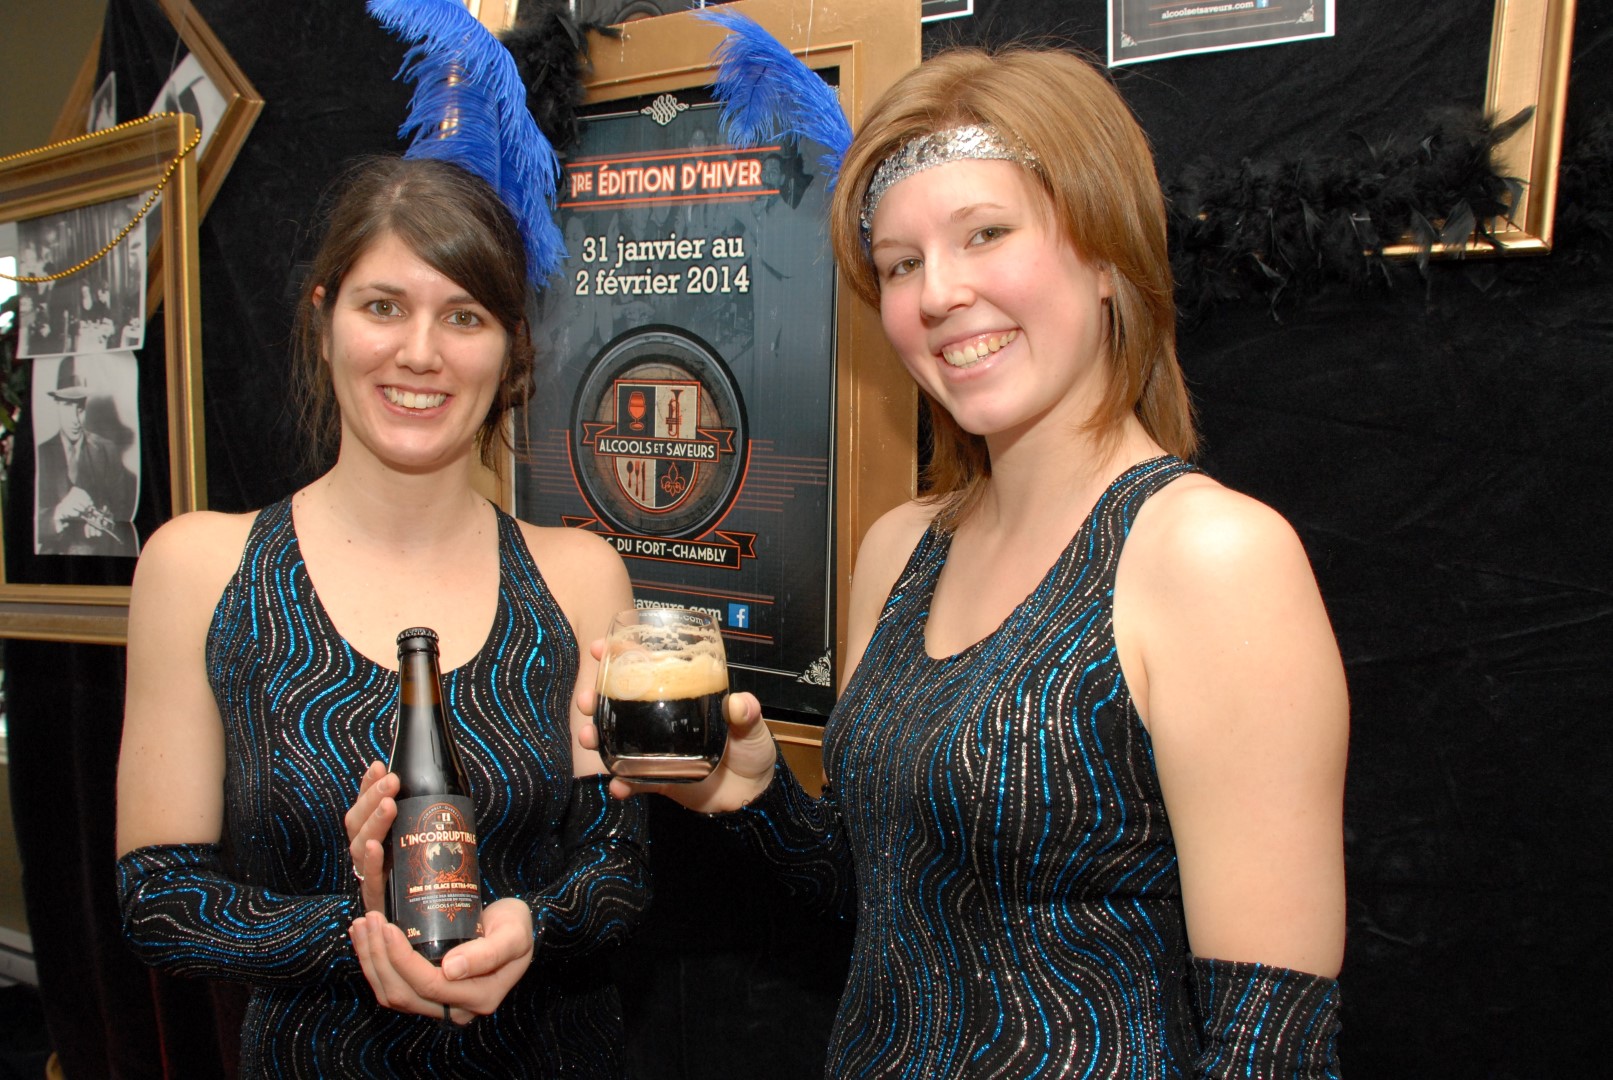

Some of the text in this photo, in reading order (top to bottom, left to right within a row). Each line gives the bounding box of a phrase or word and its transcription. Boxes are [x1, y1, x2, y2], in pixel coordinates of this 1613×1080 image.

[1161, 1, 1254, 19] alcoolsetsaveurs.com
[598, 164, 675, 197] ÉDITION
[681, 159, 762, 191] D'HIVER
[582, 233, 745, 268] 31 janvier au
[575, 265, 750, 296] 2 février 2014
[599, 439, 715, 458] ALCOOLS ET SAVEURS
[617, 538, 632, 552] DU
[635, 540, 727, 562] FORT-CHAMBLY
[400, 831, 477, 848] L'INCORRUPTIBLE
